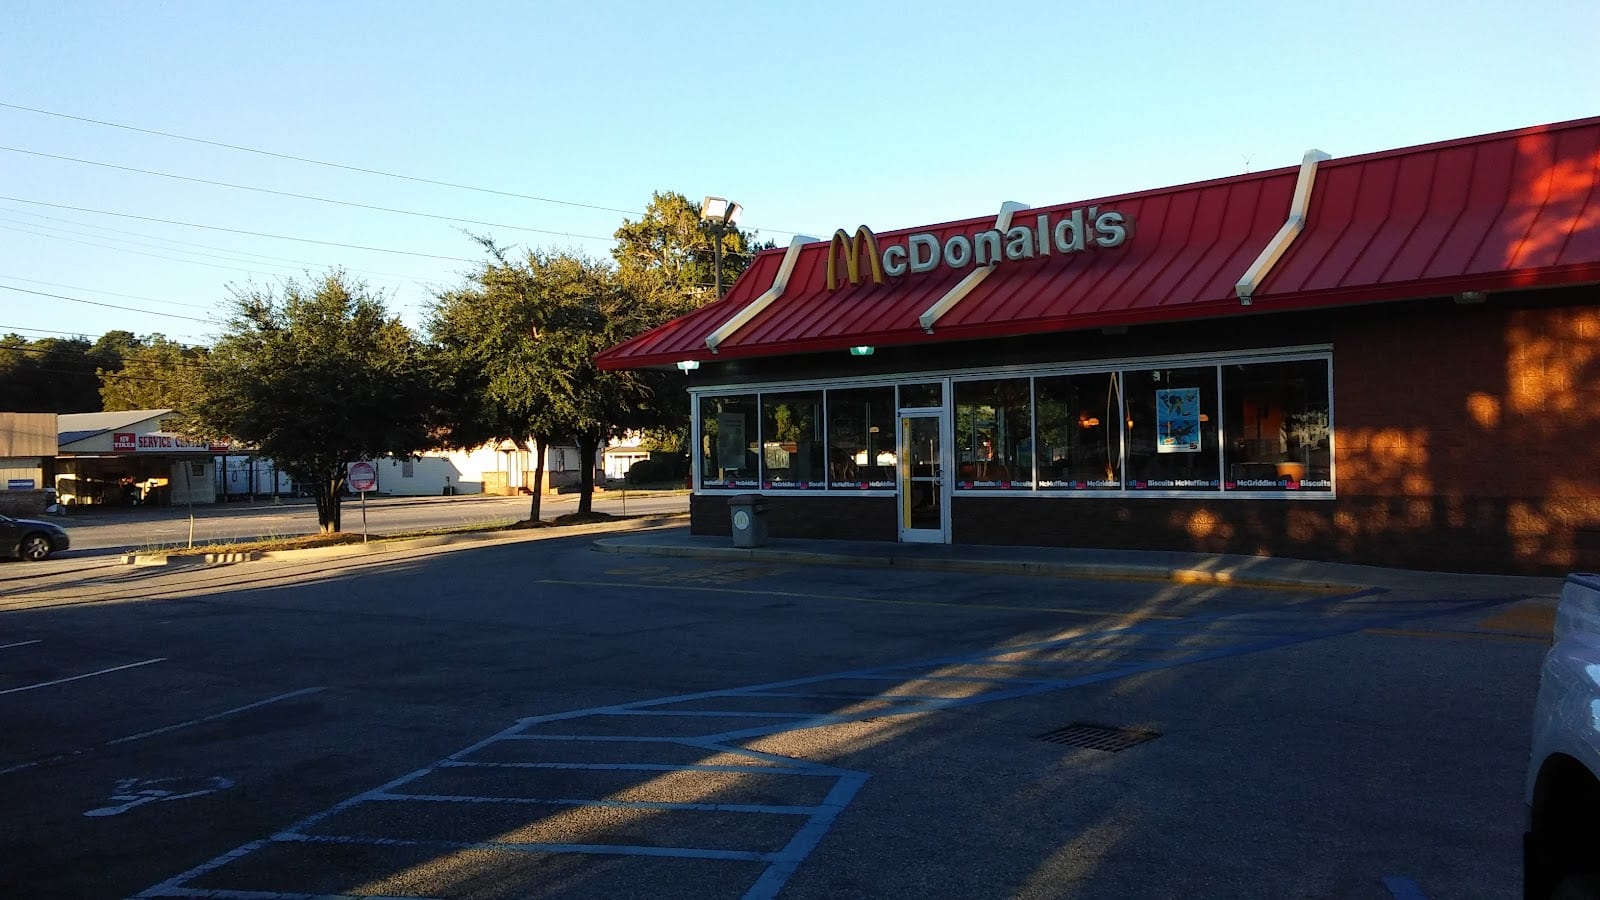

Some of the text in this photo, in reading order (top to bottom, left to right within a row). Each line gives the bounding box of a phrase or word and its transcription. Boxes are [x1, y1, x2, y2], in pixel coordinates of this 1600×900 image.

[826, 206, 1127, 290] McDonald's
[138, 436, 171, 448] SERVICE
[1147, 479, 1174, 487] Biscuits
[1174, 479, 1210, 487] McMuffins
[1236, 479, 1277, 487] McGriddles
[1299, 479, 1331, 487] Biscuits
